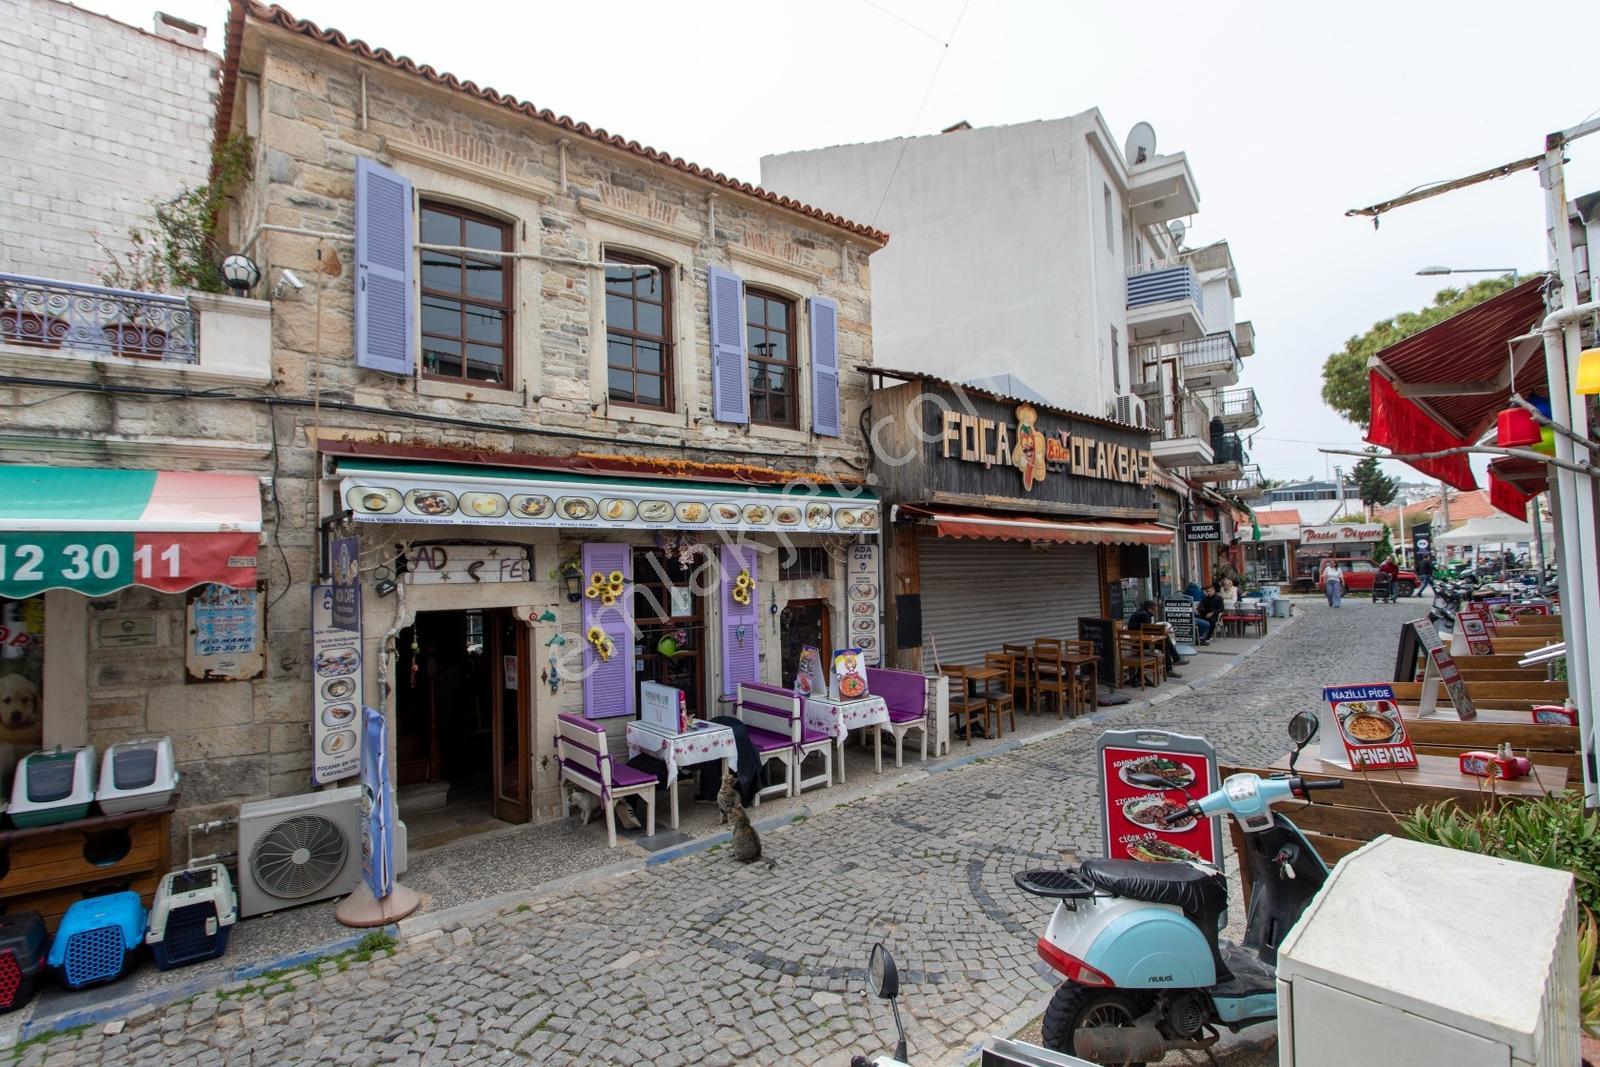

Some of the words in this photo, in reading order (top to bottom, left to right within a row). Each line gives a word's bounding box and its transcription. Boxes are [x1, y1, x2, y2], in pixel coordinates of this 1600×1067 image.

[943, 410, 1012, 469] FOÇA
[1302, 529, 1337, 543] Pasta
[61, 544, 120, 580] 30
[133, 544, 180, 578] 11
[1331, 689, 1367, 700] NAZİLLİ
[1369, 688, 1391, 699] PİDE
[1350, 747, 1414, 766] MENEMEN
